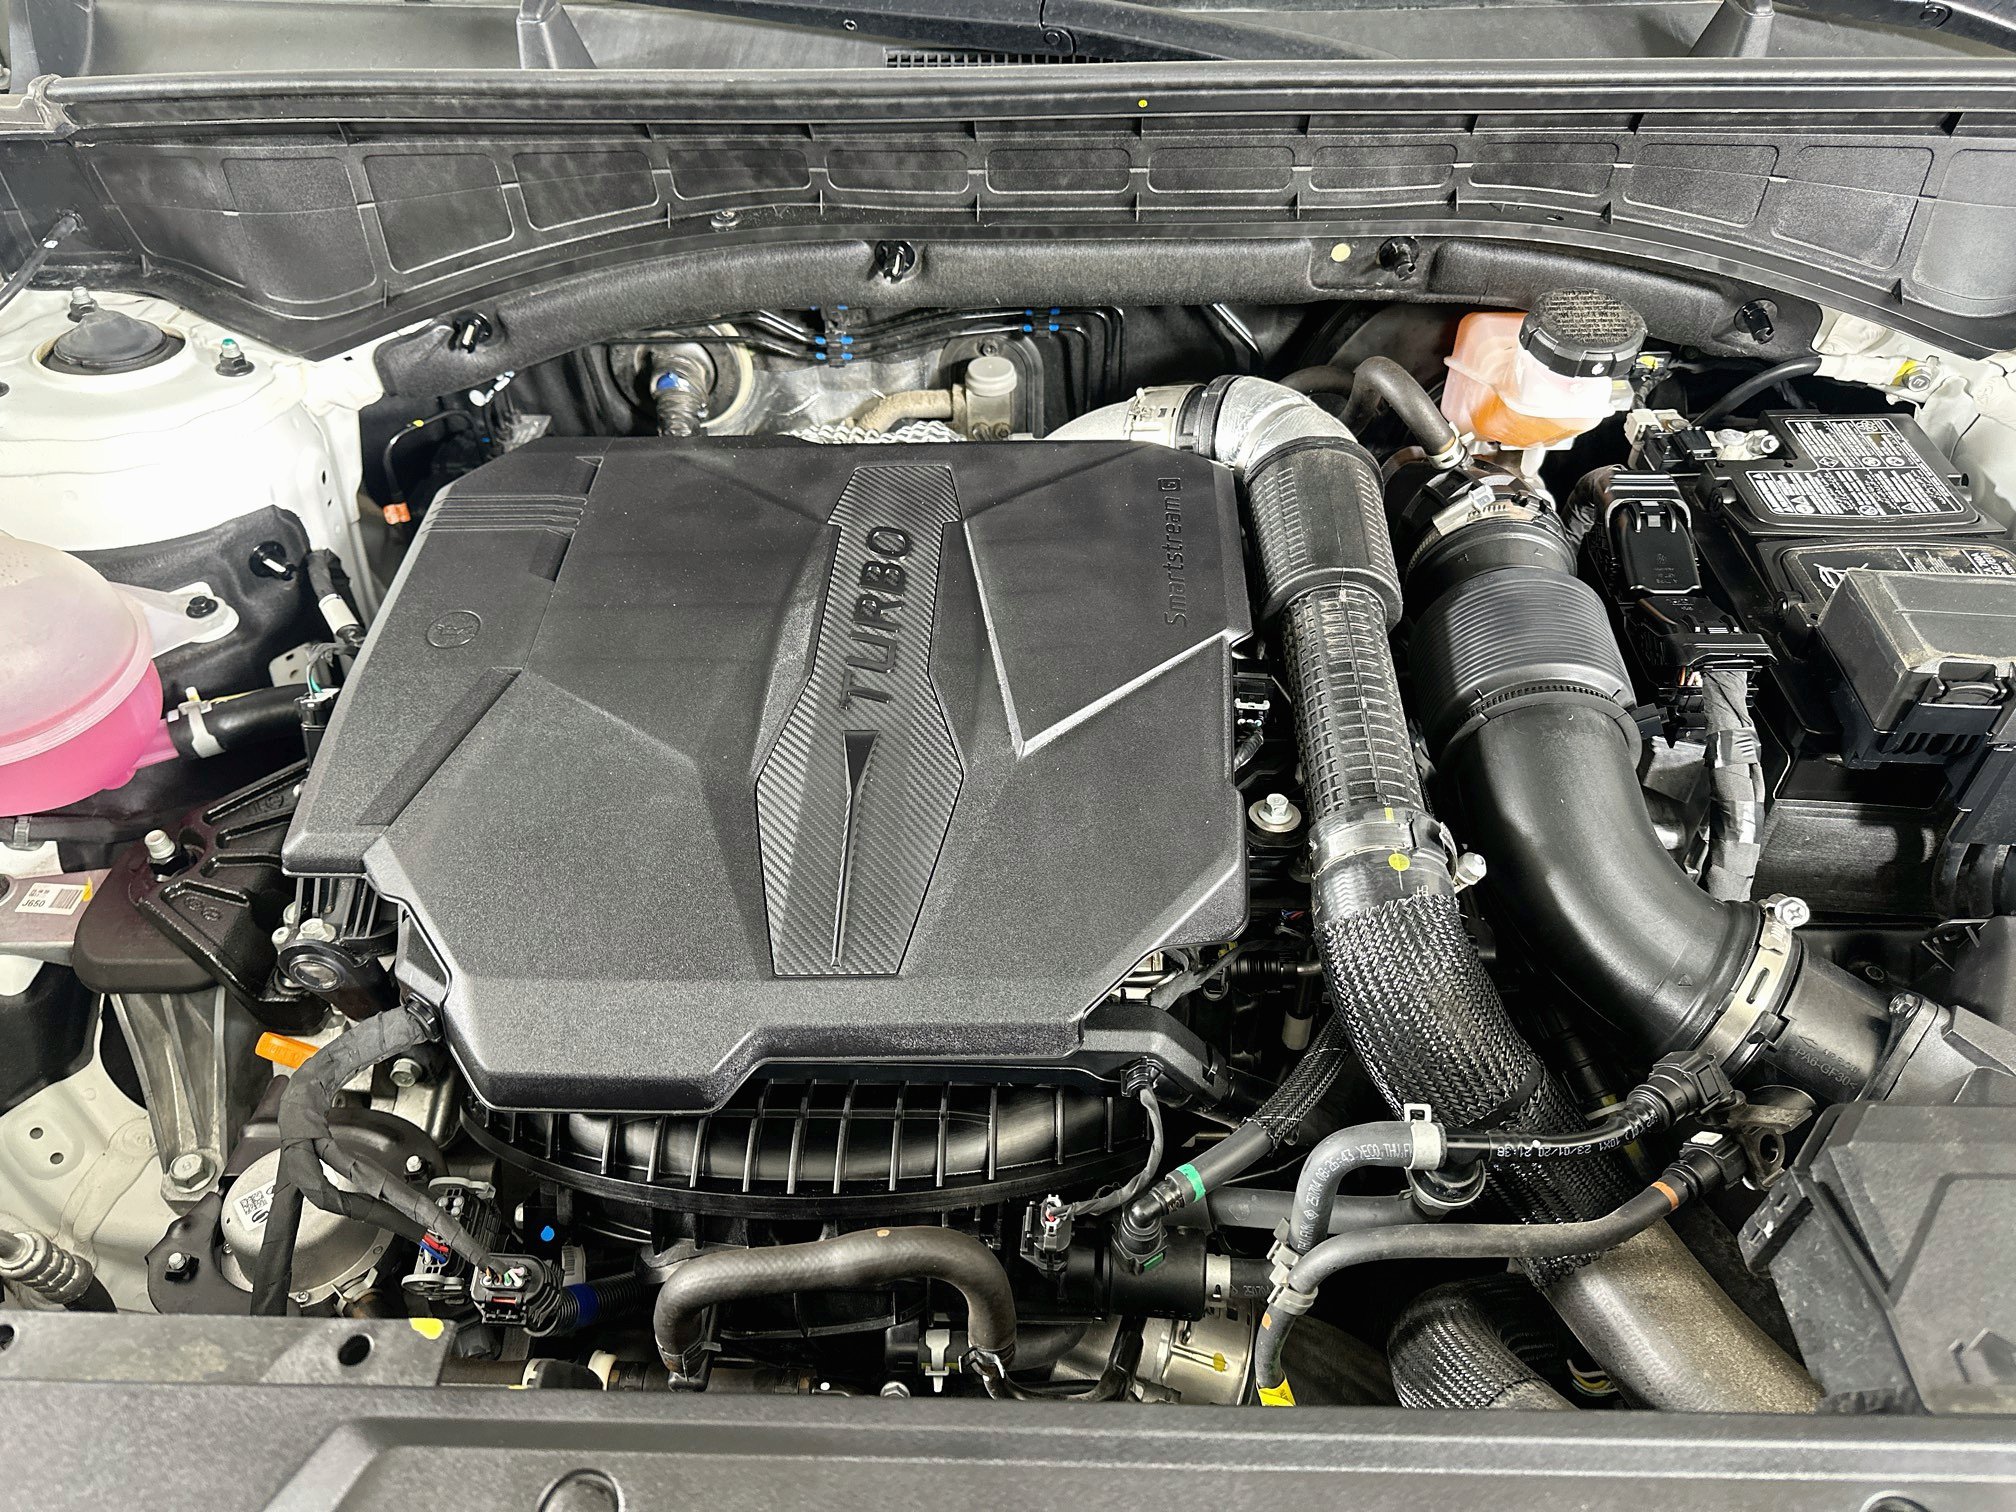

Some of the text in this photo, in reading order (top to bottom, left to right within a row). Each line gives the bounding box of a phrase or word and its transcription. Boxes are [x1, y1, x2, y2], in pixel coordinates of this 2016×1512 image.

[1161, 496, 1187, 628] Smartstream
[839, 525, 911, 710] TURBO
[22, 899, 46, 908] J650
[1497, 1145, 1532, 1158] 21:38
[1538, 1144, 1592, 1158] 23/01/20
[1319, 1149, 1355, 1182] 08:26:43
